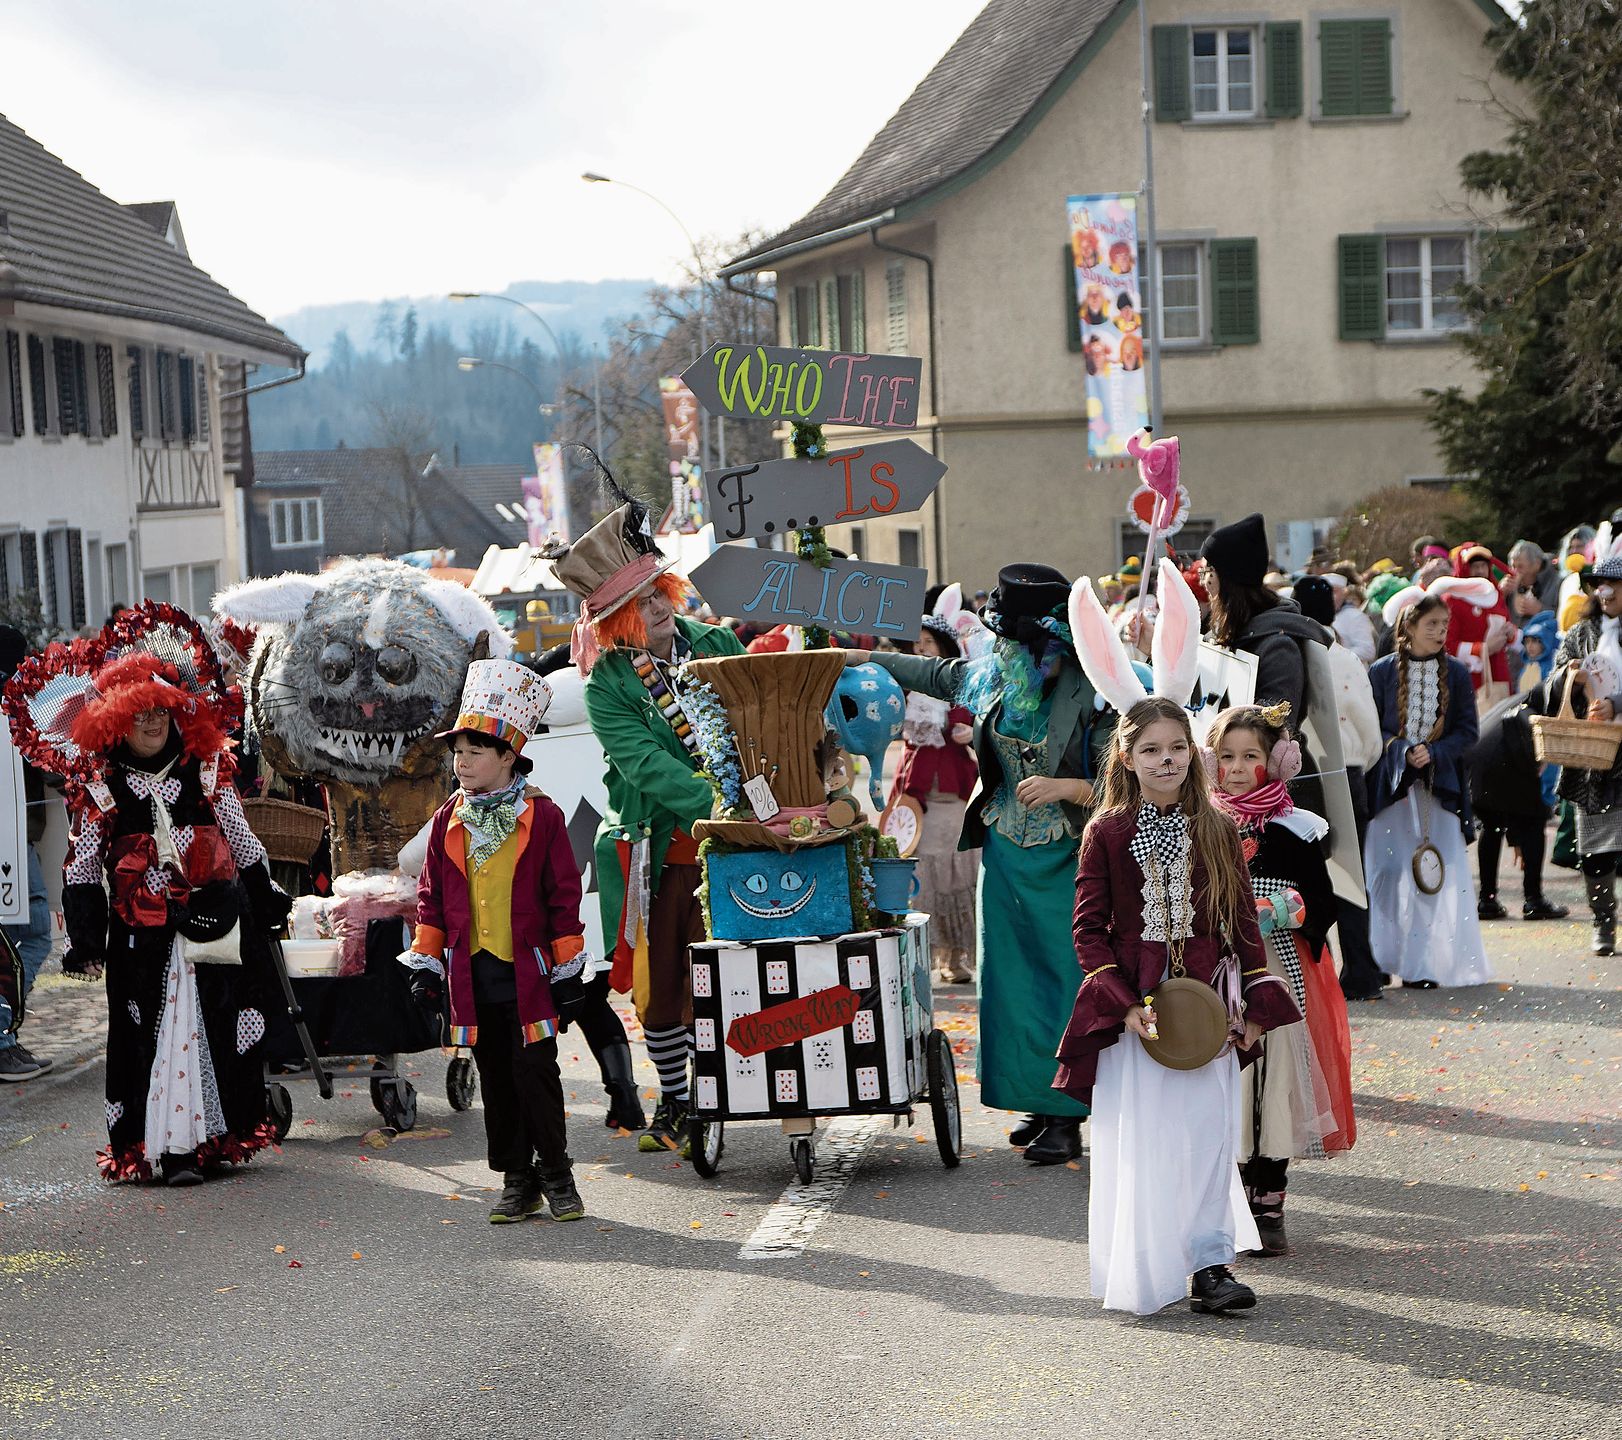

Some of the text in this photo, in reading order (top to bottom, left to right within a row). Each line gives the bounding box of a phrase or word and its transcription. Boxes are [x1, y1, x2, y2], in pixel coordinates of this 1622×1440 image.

[713, 346, 917, 428] WHO THE
[828, 448, 901, 520] IS
[742, 560, 909, 632] ALICE
[750, 781, 775, 814] 10/6
[731, 992, 856, 1050] WRONG WAY
